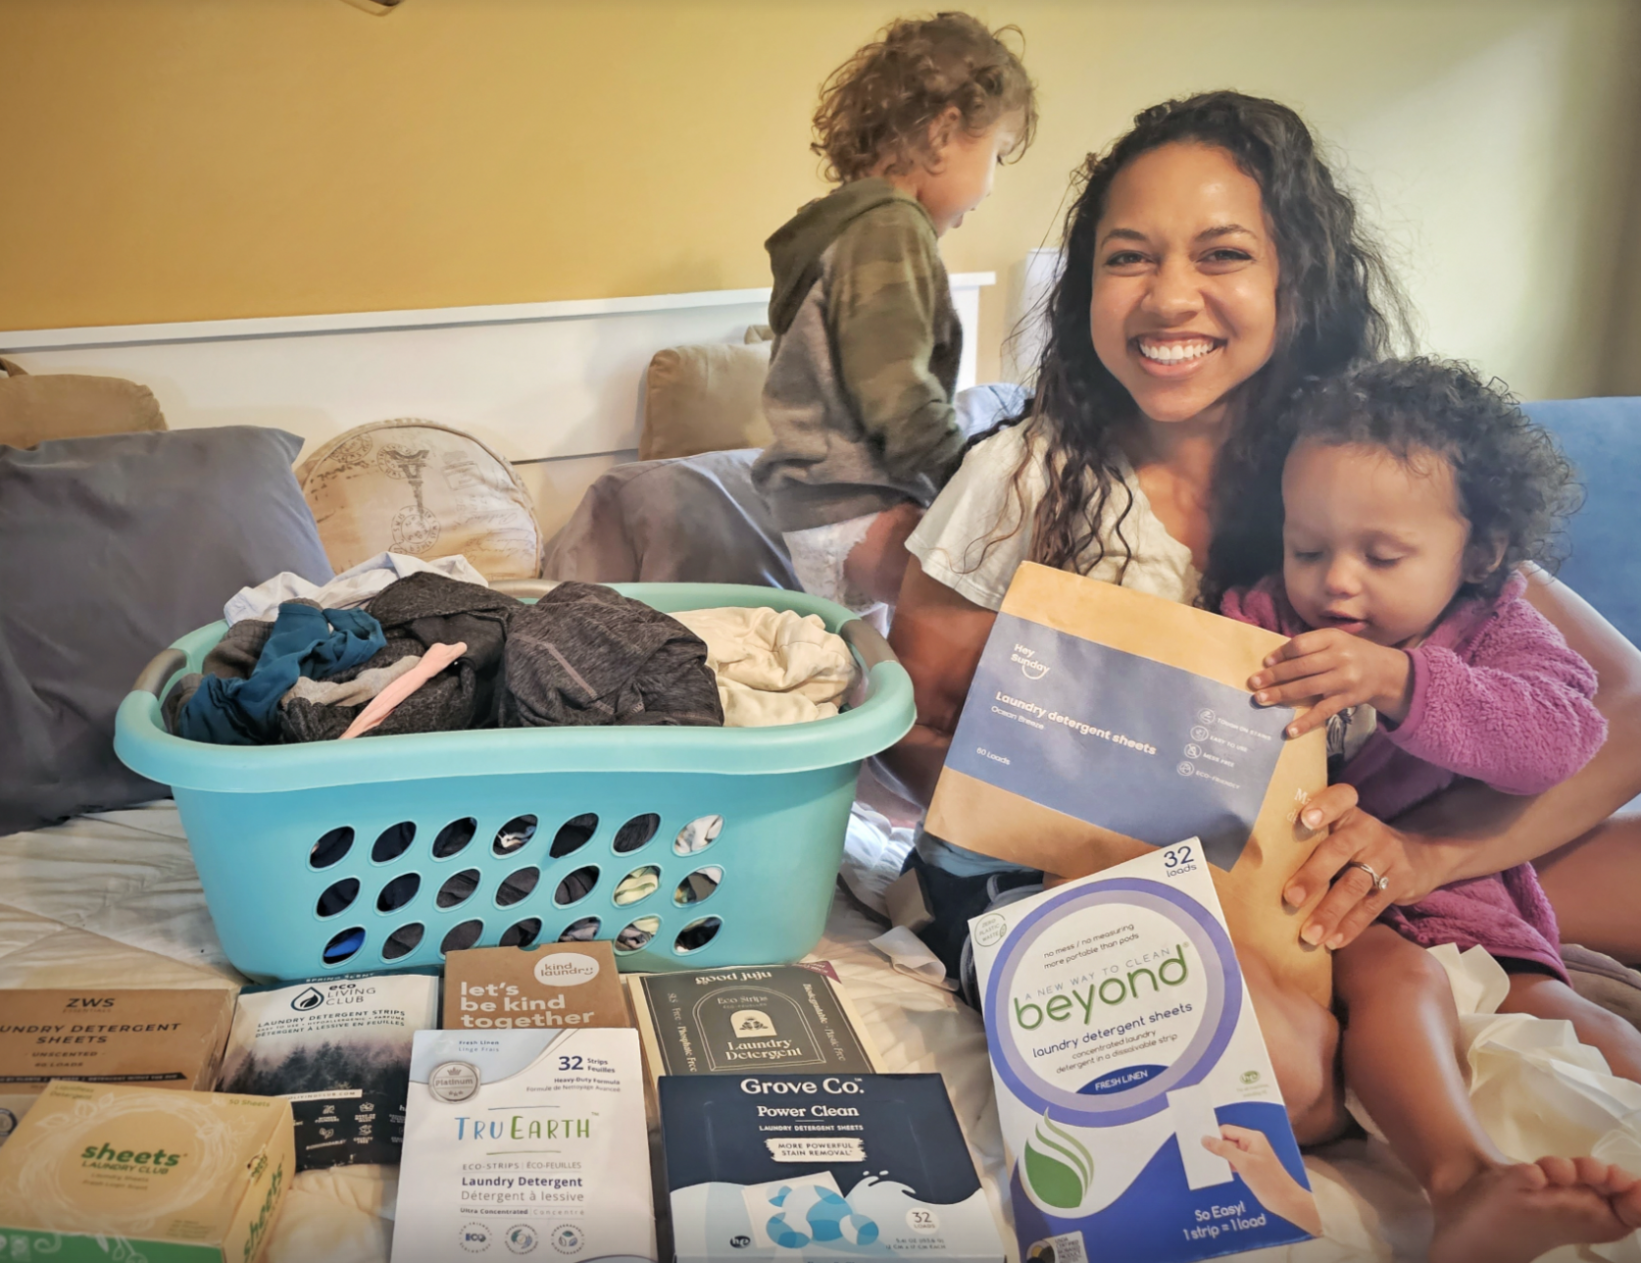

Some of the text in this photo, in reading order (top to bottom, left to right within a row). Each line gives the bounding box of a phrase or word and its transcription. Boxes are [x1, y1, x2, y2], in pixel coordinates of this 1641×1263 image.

[1014, 644, 1035, 657] Hey
[1011, 653, 1050, 674] Sunday
[991, 705, 1044, 730] Ocean Breeze
[995, 691, 1157, 755] Laundry detergent sheets
[976, 747, 1011, 765] 60 Loads
[1163, 845, 1194, 868] 32
[1166, 863, 1197, 877] loads
[1043, 950, 1055, 958] no
[1055, 943, 1075, 955] mess
[1081, 937, 1092, 945] no
[1093, 923, 1135, 941] measuring
[1043, 933, 1139, 970] more portable than pods
[541, 967, 593, 977] laundry
[544, 962, 572, 970] kind
[1037, 983, 1064, 996] NEW
[1070, 972, 1095, 986] WAY
[1102, 965, 1120, 976] TO
[1125, 948, 1171, 968] CLEAN
[695, 971, 772, 985] good juju
[327, 987, 377, 998] LIVING
[329, 983, 357, 991] eco
[461, 981, 520, 996] let's
[1014, 944, 1189, 1030] beyond
[66, 998, 116, 1007] ZWS
[326, 996, 364, 1006] CLUB
[461, 994, 566, 1011] be kind
[717, 997, 738, 1005] Eco
[257, 1017, 305, 1028] LAUNDRY
[309, 1011, 369, 1021] DETERGENT
[316, 1022, 349, 1031] LESSIVE
[461, 1011, 595, 1029] together
[71, 1023, 181, 1033] DETERGENT
[1033, 1003, 1193, 1058] laundry detergent sheets
[36, 1036, 107, 1044] SHEETS
[727, 1039, 792, 1051] Laundry
[1072, 1029, 1156, 1060] concentrated laundry
[725, 1048, 803, 1061] Detergent
[1056, 1057, 1095, 1074] detergent
[1097, 1054, 1104, 1062] in
[1112, 1040, 1157, 1058] dissolvable
[1158, 1033, 1178, 1046] strip
[558, 1056, 608, 1071] 32 Strips
[587, 1065, 616, 1073] Feuilles
[435, 1078, 473, 1086] Platinum
[740, 1078, 818, 1094] Grove
[1095, 1069, 1148, 1091] FRESH LINEN
[526, 1085, 552, 1093] Formule
[756, 1105, 860, 1117] Power Clean
[81, 1142, 181, 1167] sheets
[81, 1161, 170, 1175] LAUNDRY CLUB
[462, 1160, 582, 1170] ECO-STRIPS ÉCO-FEUILLES
[462, 1176, 583, 1189] Laundry Detergent
[461, 1190, 584, 1203] Détergent à lessive
[533, 1208, 585, 1216] Concentré
[912, 1211, 932, 1223] 32
[1194, 1200, 1246, 1222] So Easy!
[1191, 1225, 1220, 1240] strip
[1237, 1213, 1266, 1230] load
